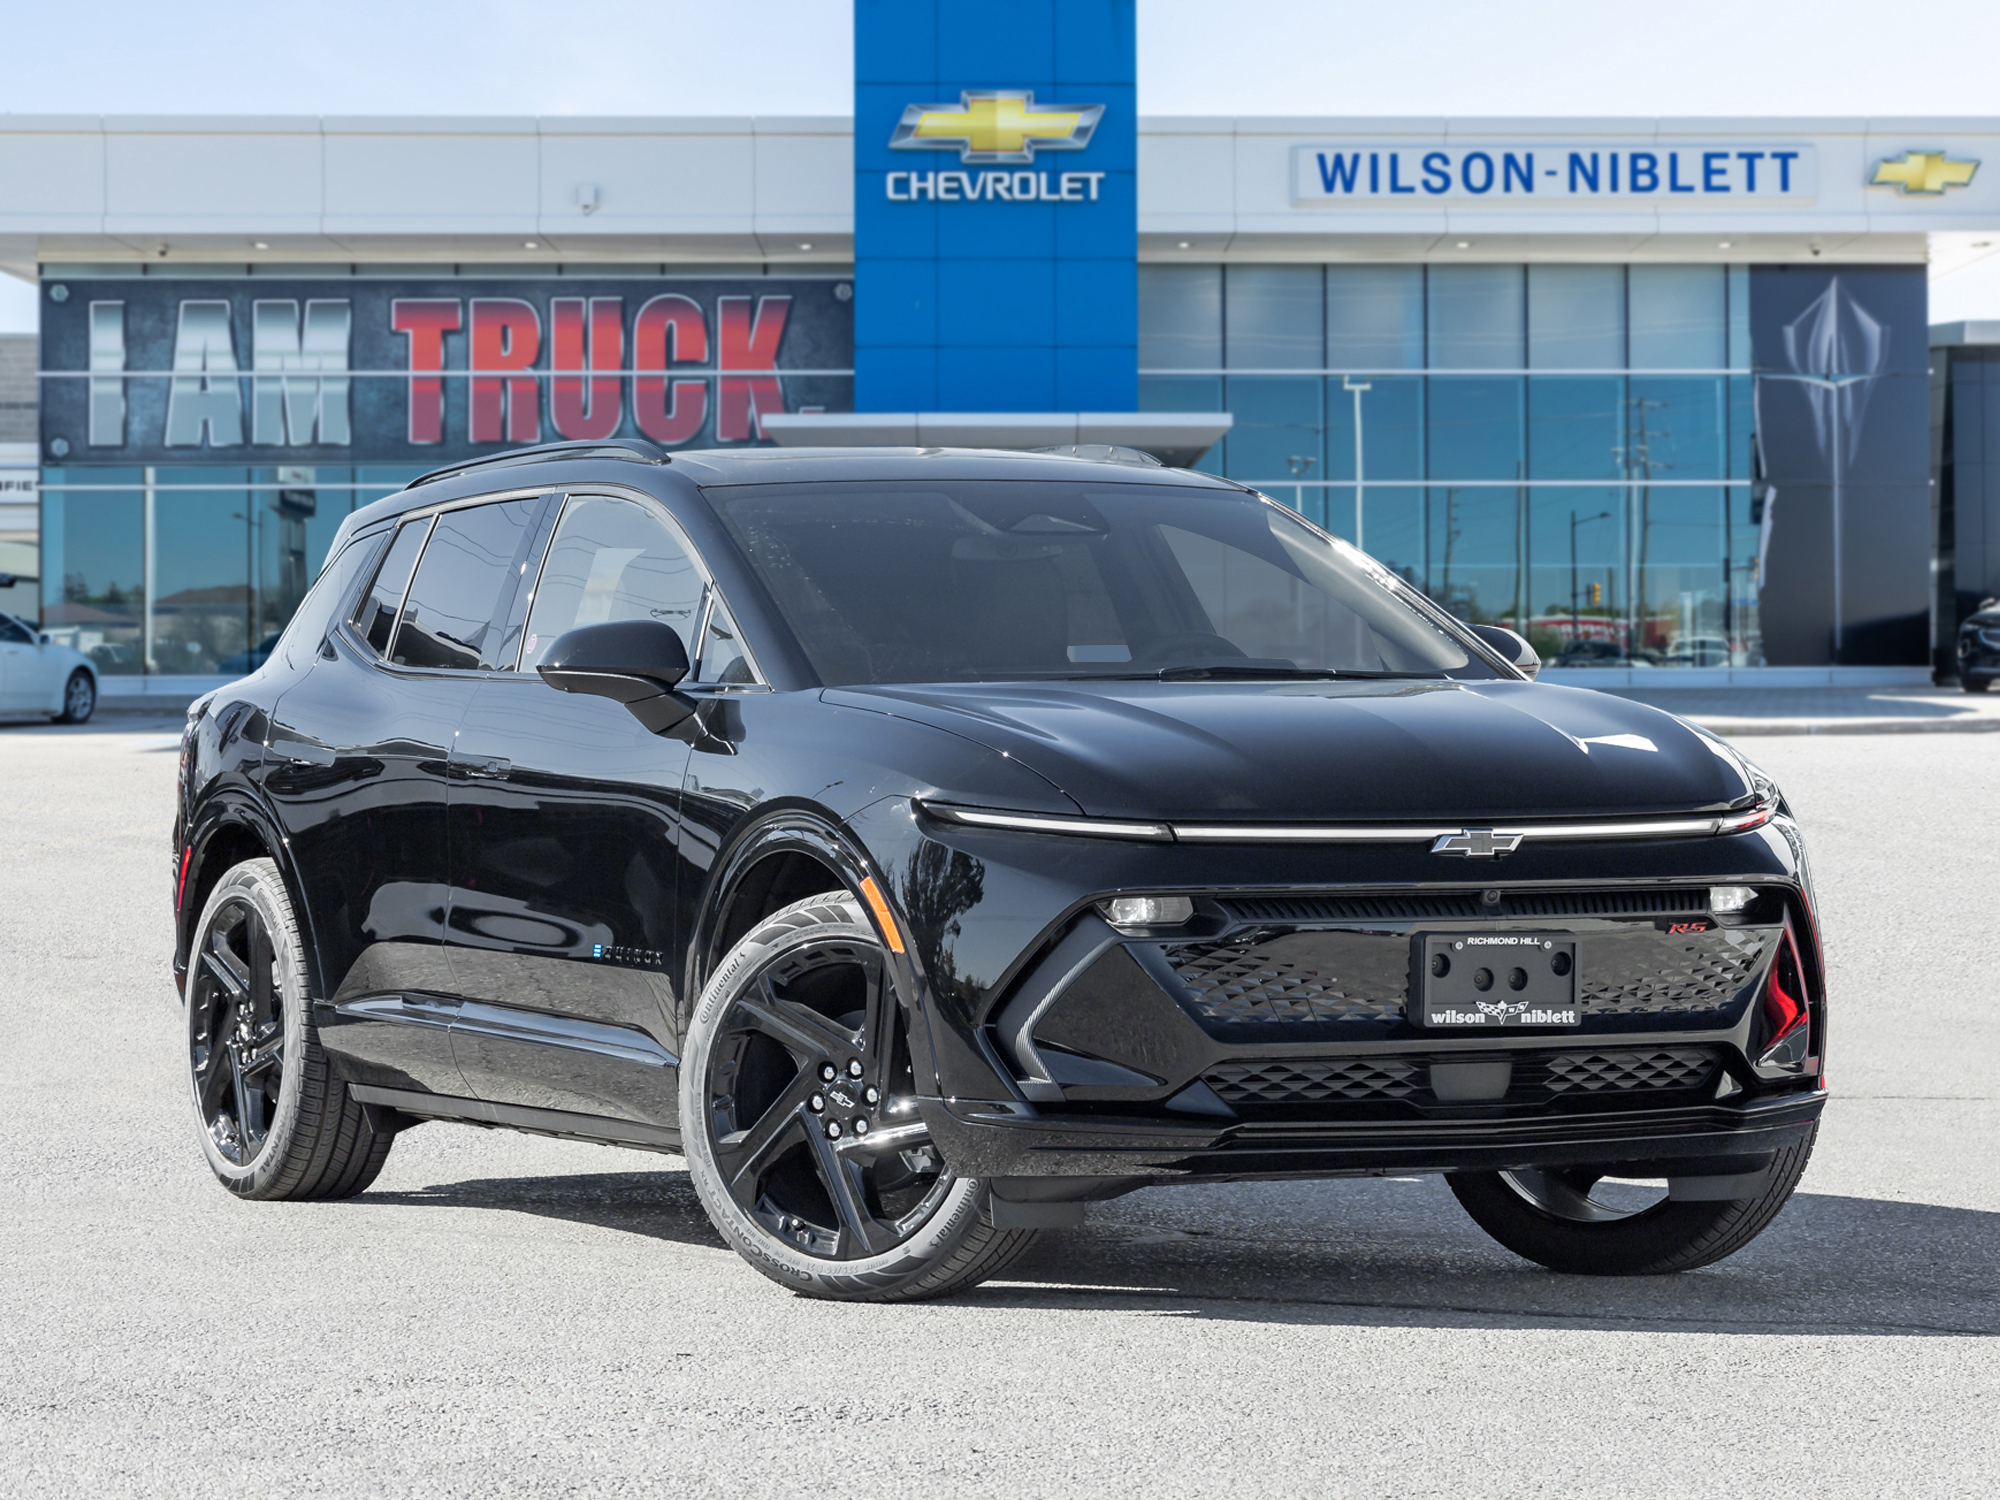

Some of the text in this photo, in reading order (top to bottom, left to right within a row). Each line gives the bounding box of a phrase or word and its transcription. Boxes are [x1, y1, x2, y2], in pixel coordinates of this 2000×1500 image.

[886, 171, 1105, 200] CHEVROLET
[1316, 151, 1800, 193] WILSON-NIBLETT
[88, 298, 127, 448] I
[164, 298, 353, 448] AM
[1467, 937, 1540, 945] RICHMOND HILL
[1669, 922, 1707, 934] RS
[700, 958, 740, 1024] Continental
[1431, 1009, 1575, 1024] wilson niblett
[708, 1189, 813, 1282] CROSSCONTACT
